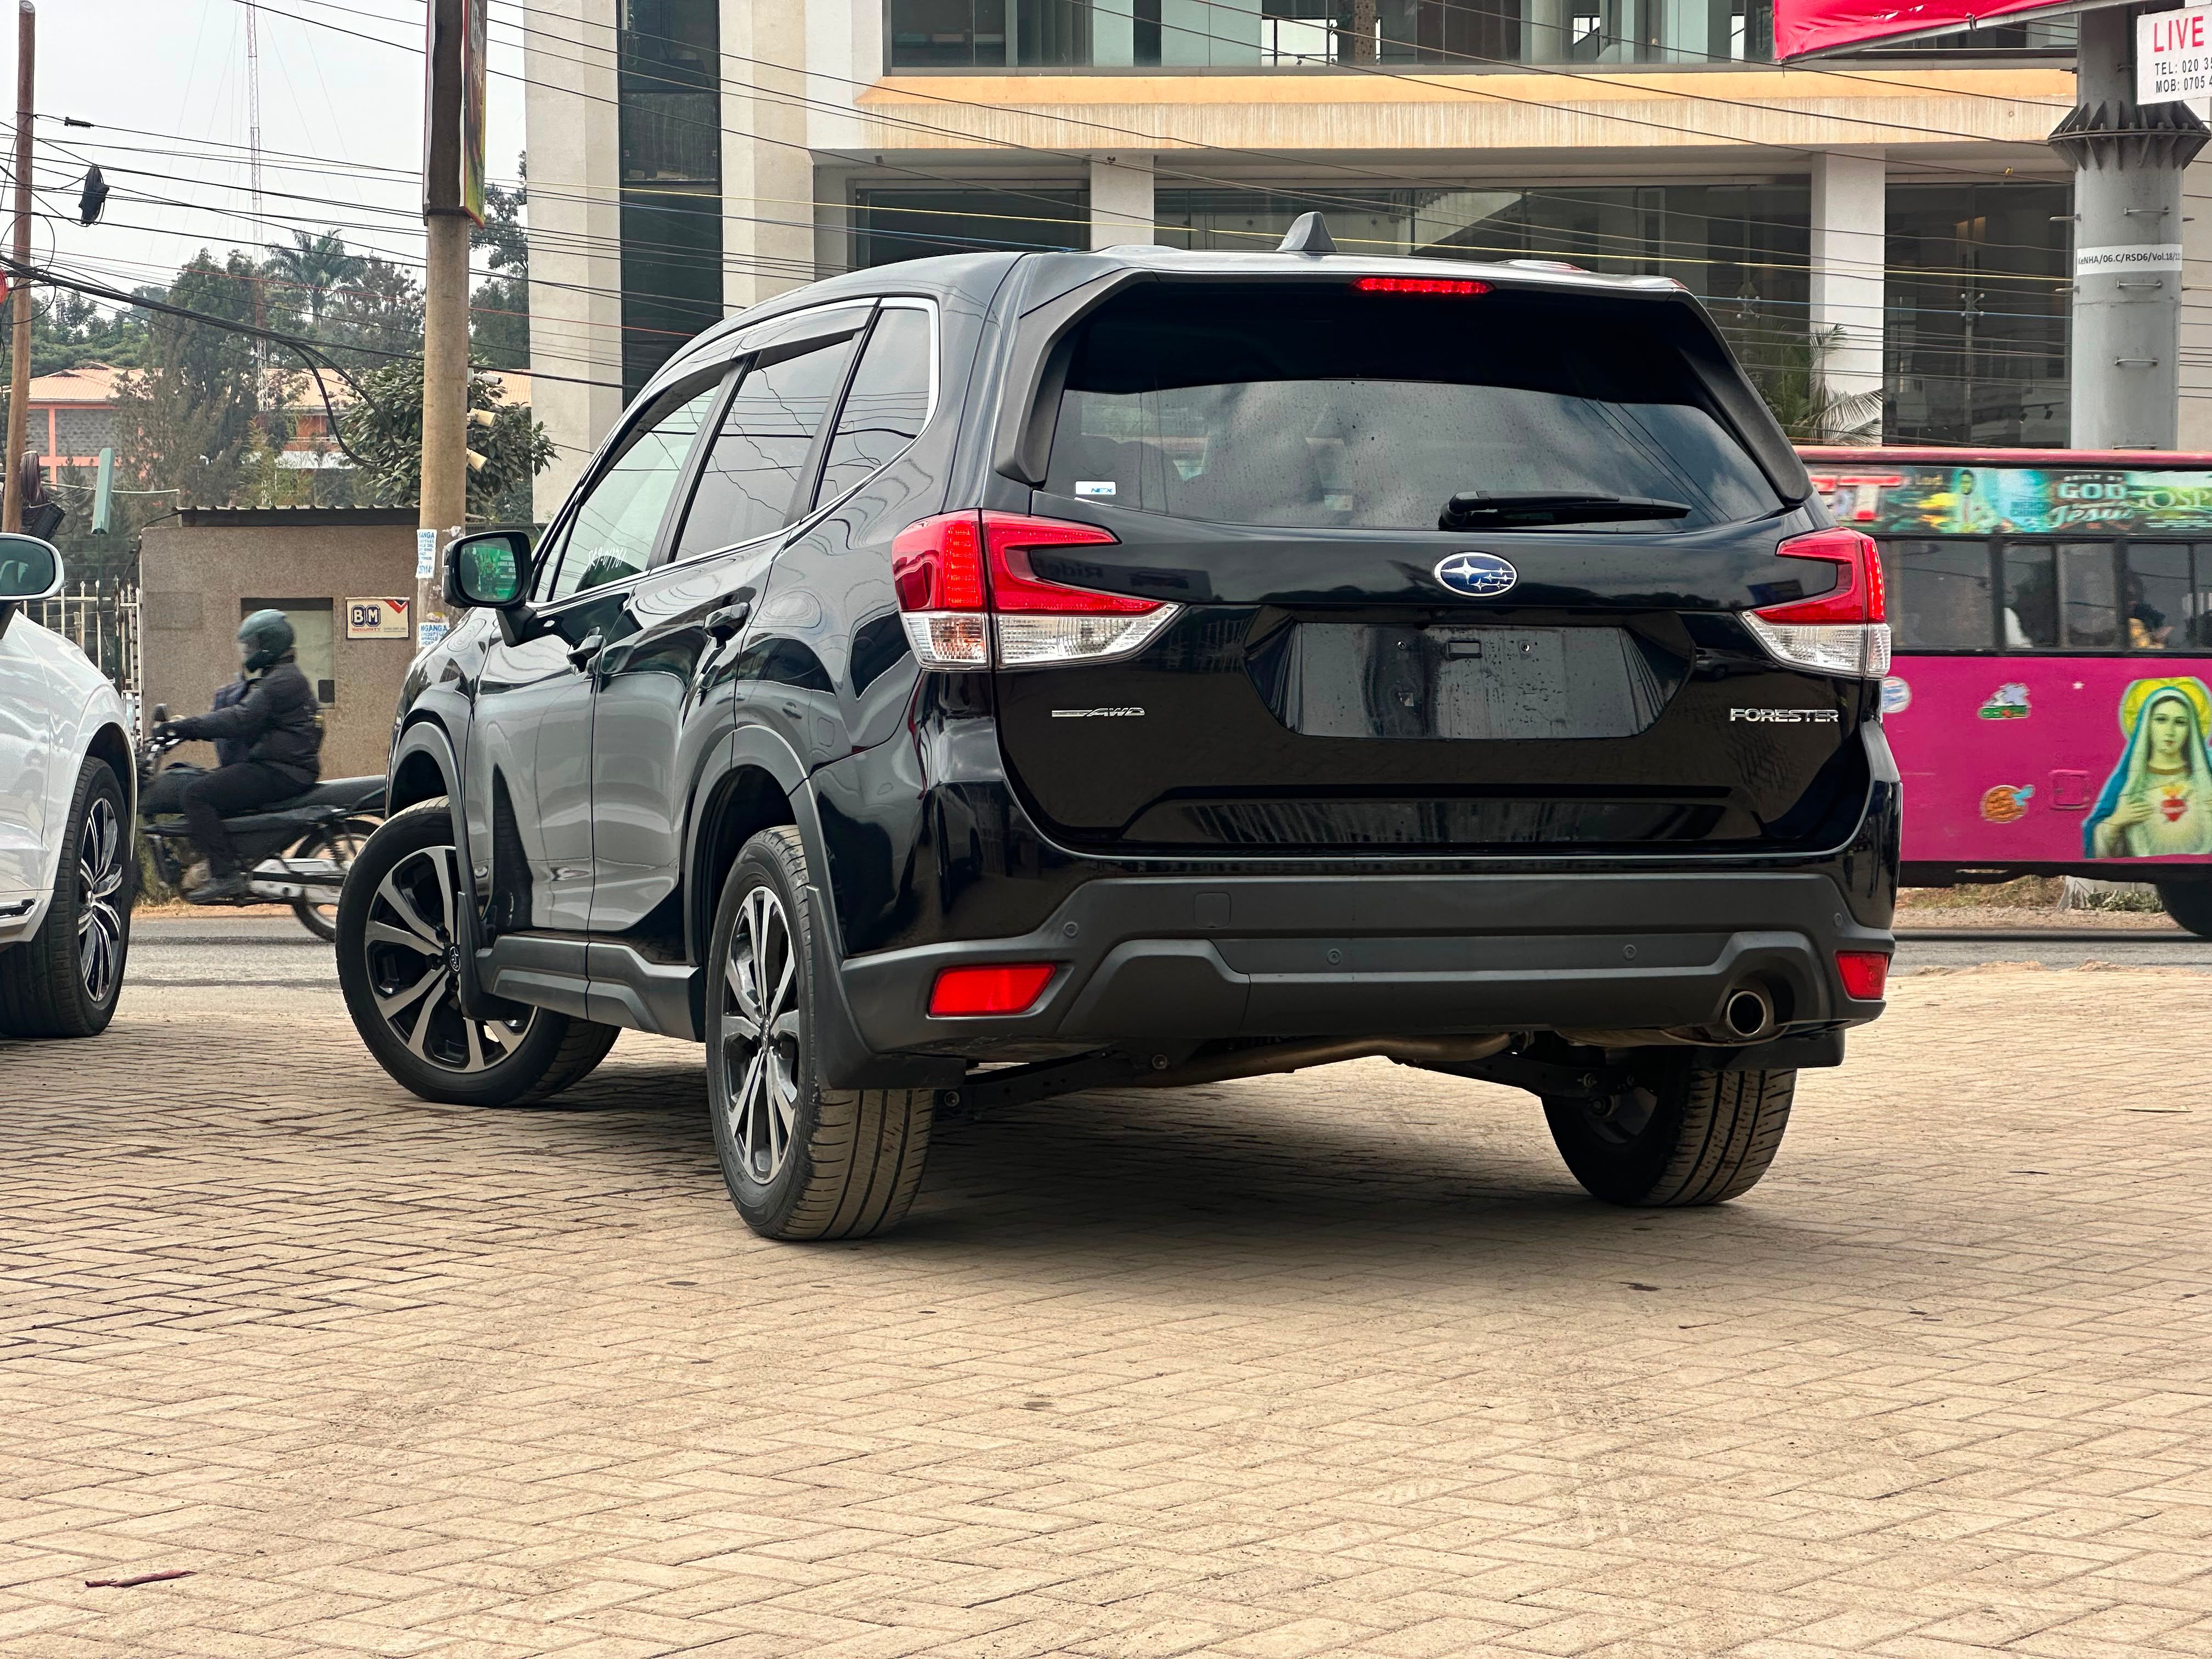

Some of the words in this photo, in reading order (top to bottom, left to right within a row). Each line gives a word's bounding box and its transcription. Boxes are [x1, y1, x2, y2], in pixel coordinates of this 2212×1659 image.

[2154, 16, 2204, 52] LIVE
[2155, 61, 2177, 75] TEL:
[2182, 58, 2198, 72] 020
[2156, 79, 2180, 93] MOB:
[2184, 75, 2205, 91] 0705
[2058, 483, 2127, 500] GOD
[353, 607, 379, 624] BM
[1086, 707, 1146, 717] AWD
[1729, 708, 1839, 723] FORESTER
